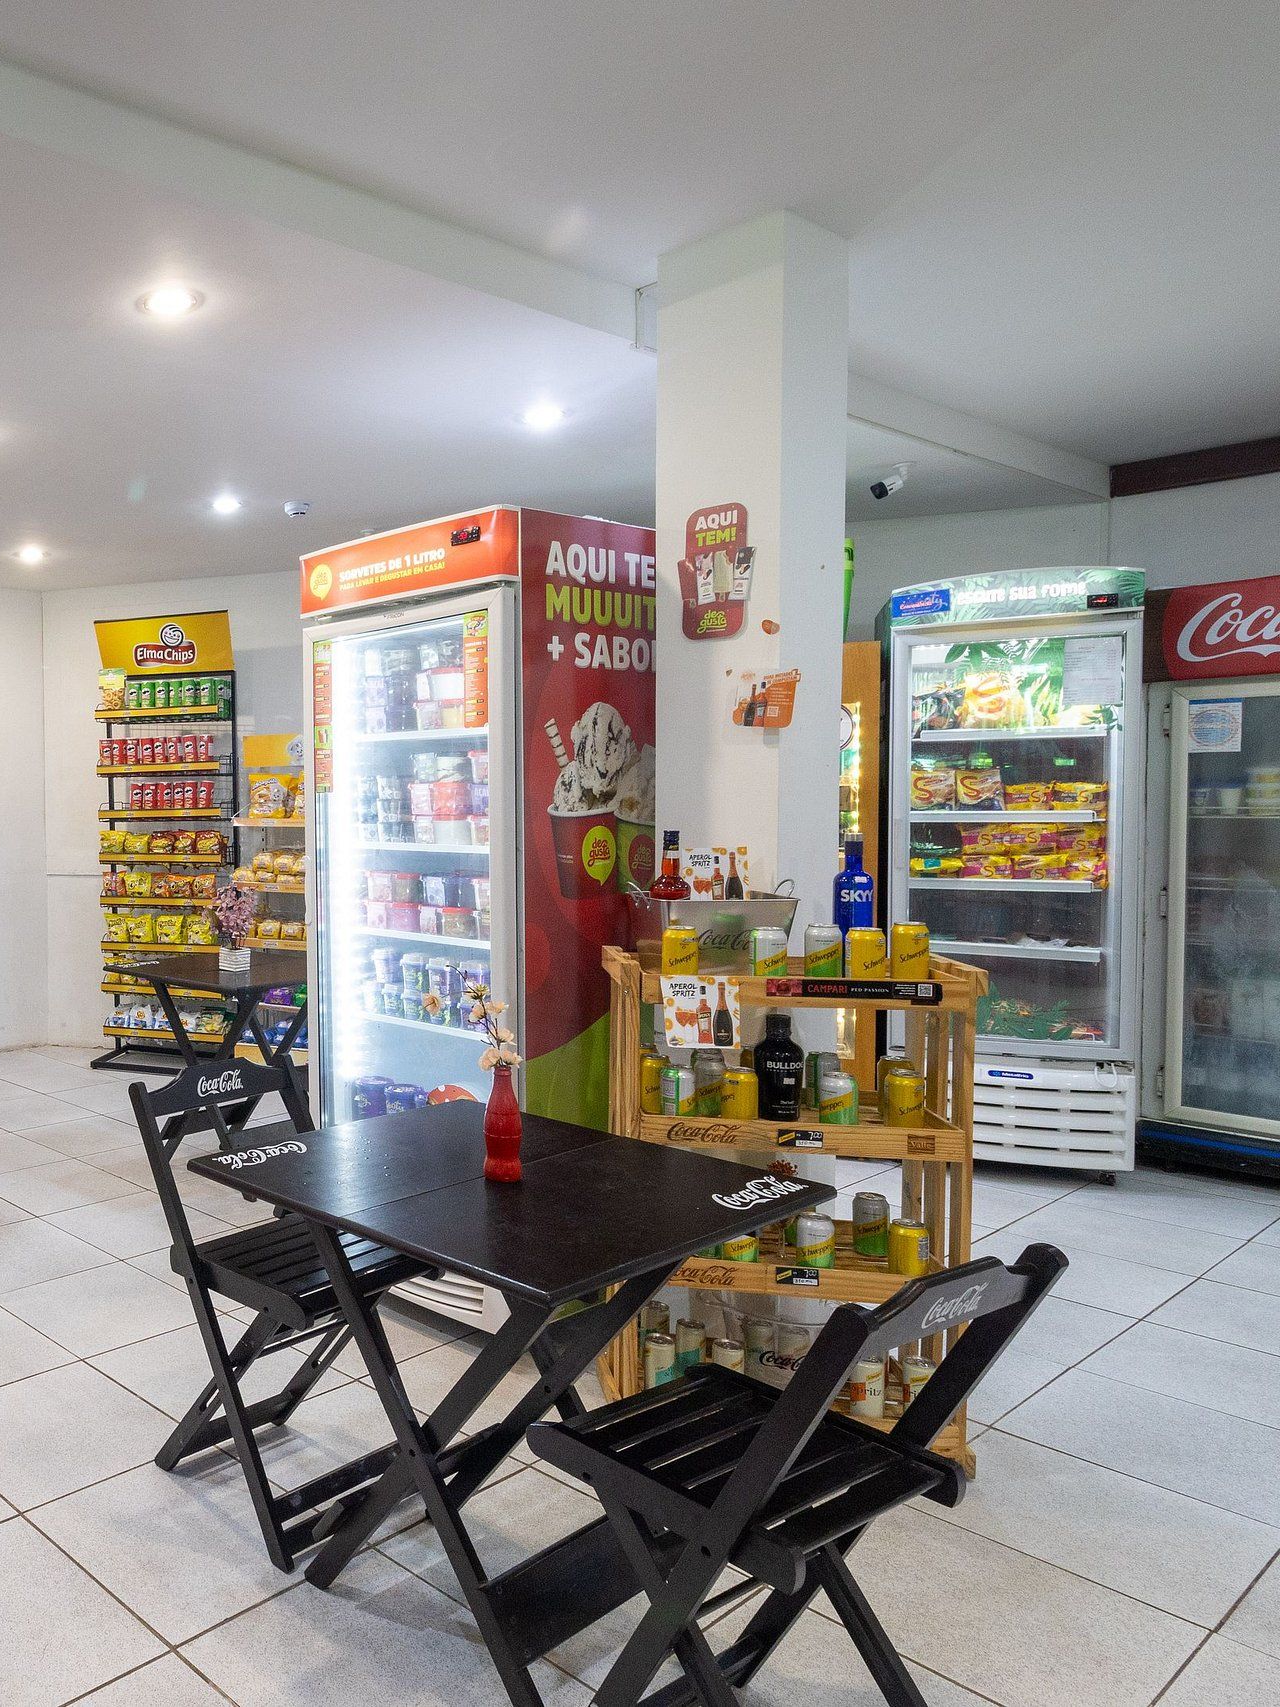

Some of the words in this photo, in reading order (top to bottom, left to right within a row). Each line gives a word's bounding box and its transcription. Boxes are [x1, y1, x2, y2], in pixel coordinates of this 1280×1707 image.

[695, 509, 738, 532] AQUI
[695, 526, 737, 547] TEM!
[339, 561, 387, 583] SORVETES
[388, 557, 402, 571] DE
[404, 555, 410, 567] 1
[413, 548, 446, 566] LITRO
[545, 540, 616, 585] AQUI
[624, 551, 656, 589] TE
[380, 571, 413, 582] DEGUSTAR
[1009, 585, 1037, 601] sua
[545, 583, 656, 632] MUUUIT
[688, 854, 712, 862] APEROL
[691, 860, 711, 868] SPRITZ
[840, 889, 874, 903] SKYY
[669, 983, 698, 991] APEROL
[672, 989, 696, 998] SPRITZ
[806, 984, 848, 995] CAMPARI
[766, 1061, 805, 1070] BULLDOG
[197, 1069, 244, 1098] Coca-Cola
[667, 1122, 743, 1144] Coca-Cola
[213, 1140, 308, 1169] Coca-Cola
[712, 1175, 808, 1210] Coca-Cola
[922, 1281, 990, 1329] Coca-Cola
